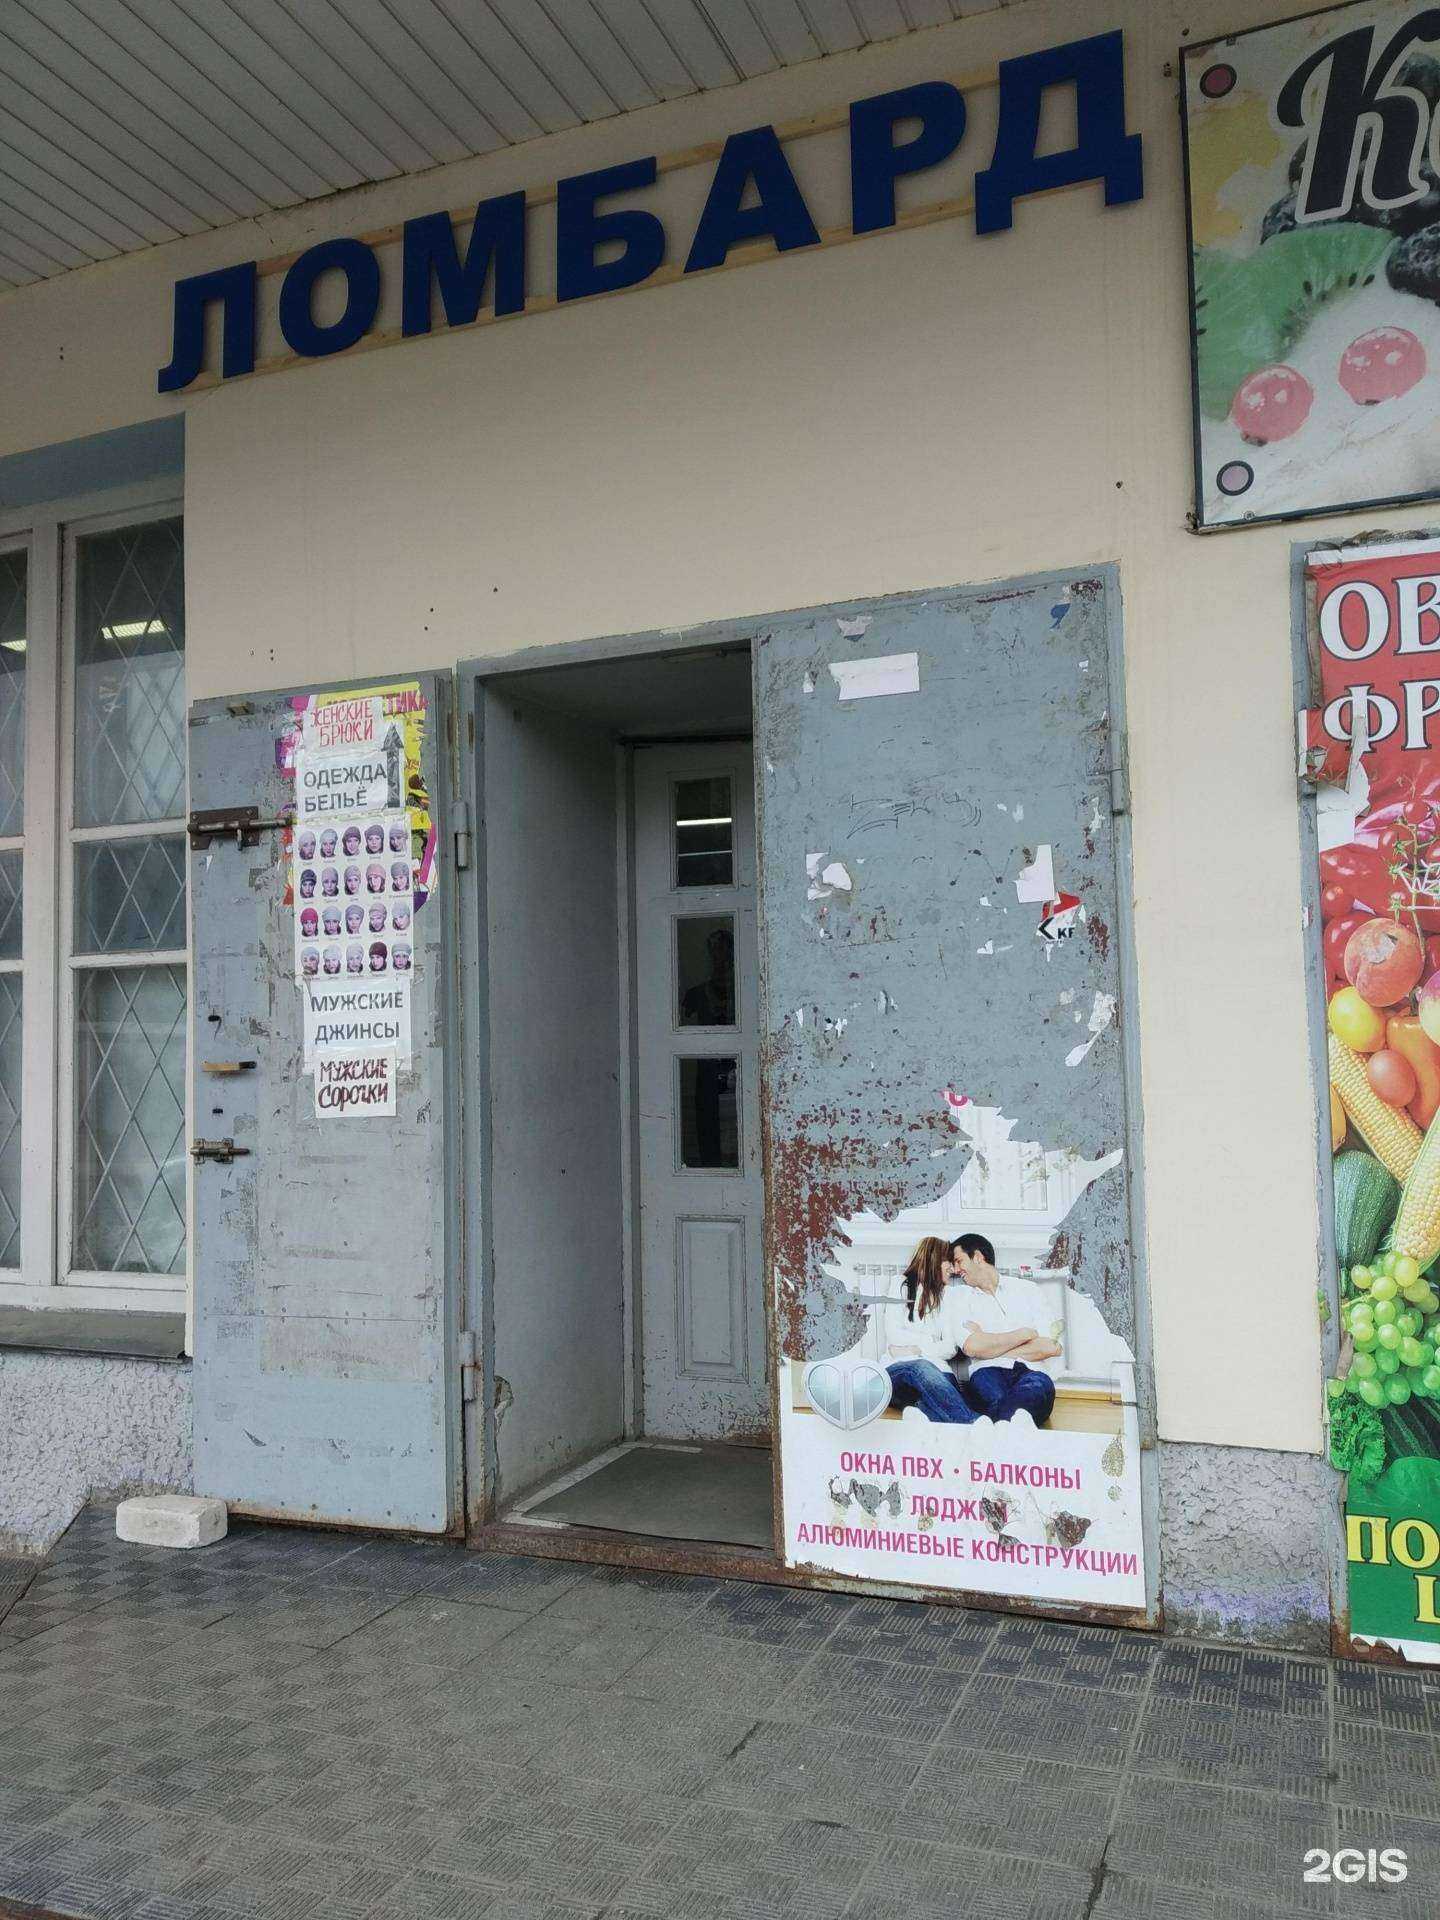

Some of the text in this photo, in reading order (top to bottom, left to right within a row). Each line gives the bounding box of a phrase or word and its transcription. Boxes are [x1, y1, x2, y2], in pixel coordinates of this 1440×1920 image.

[1277, 8, 1440, 215] К
[157, 29, 1144, 394] ЛОМБАРД
[310, 699, 374, 728] ЖЕНСКИЕ
[319, 718, 374, 748] БРЮКИ
[303, 764, 388, 790] ОДЕЖДА
[304, 786, 368, 813] БЕЛЬЁ
[311, 991, 404, 1012] МУЖСКИЕ
[315, 1021, 400, 1045] ДЖИНСЫ
[319, 1057, 389, 1083] МУЖСКИЕ
[839, 1451, 1081, 1490] ОКНА ПВХ БАЛКОНЫ
[797, 1522, 1138, 1576] АЛЮМИНИЕВЫЕ КОНСТРУКЦИИ
[1346, 1513, 1440, 1570] ПО
